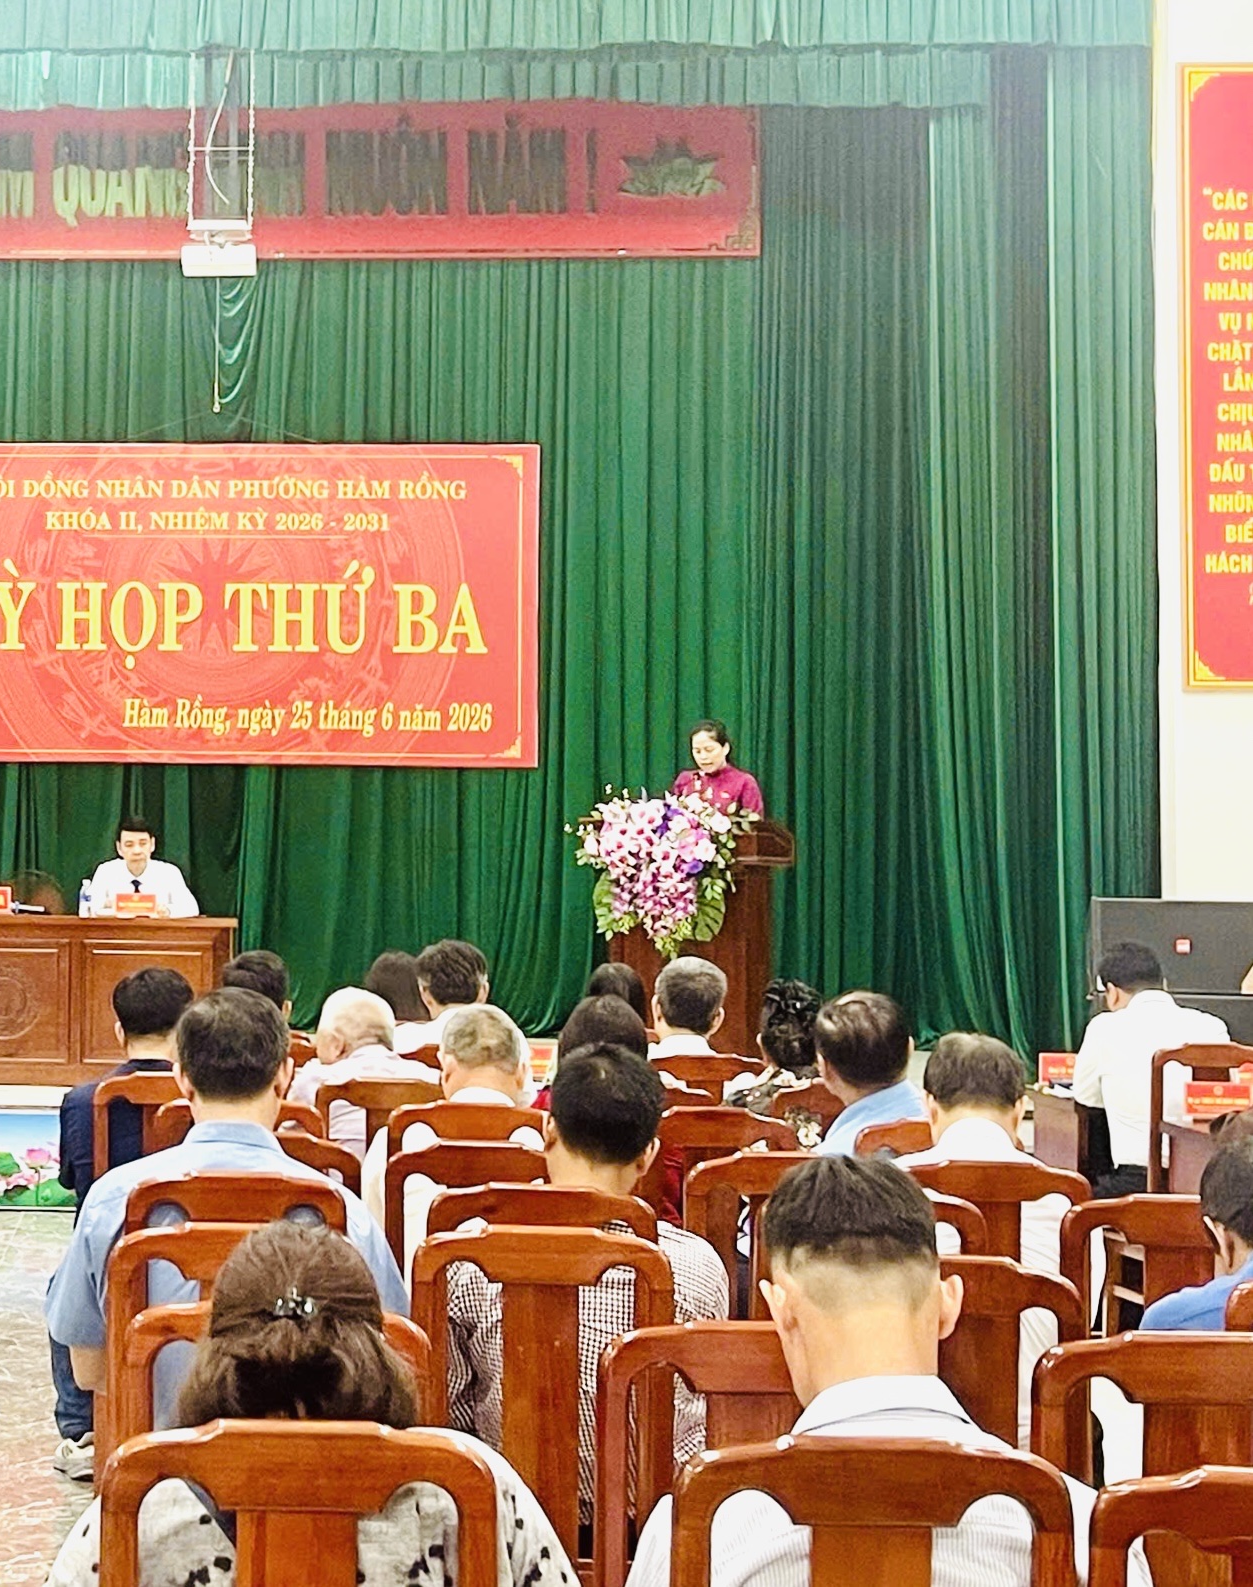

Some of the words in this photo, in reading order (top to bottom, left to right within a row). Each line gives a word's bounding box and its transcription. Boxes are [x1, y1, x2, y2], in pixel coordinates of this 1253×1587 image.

[1202, 218, 1240, 241] CÁN
[1218, 311, 1242, 335] VỤ
[22, 470, 89, 499] ĐỒNG
[95, 475, 164, 499] NHÂN
[170, 475, 221, 499] DÂN
[228, 475, 330, 500] PHƯỜNG
[336, 475, 392, 500] HÀM
[398, 470, 467, 500] RỒNG
[45, 506, 113, 531] KHÓA
[119, 511, 144, 534] II,
[149, 506, 230, 535] NHIỆM
[237, 506, 270, 531] KỲ
[275, 512, 325, 532] 2026
[343, 513, 391, 532] 2031
[55, 580, 204, 671] HỌP
[224, 559, 376, 655] THỨ
[392, 582, 489, 655] BA
[122, 697, 170, 729] Hàm
[173, 693, 232, 737] Rồng,
[237, 699, 286, 738] ngày
[289, 700, 314, 731] 25
[318, 699, 378, 739] tháng
[381, 702, 395, 732] 6
[397, 703, 443, 732] năm
[446, 702, 494, 733] 2026
